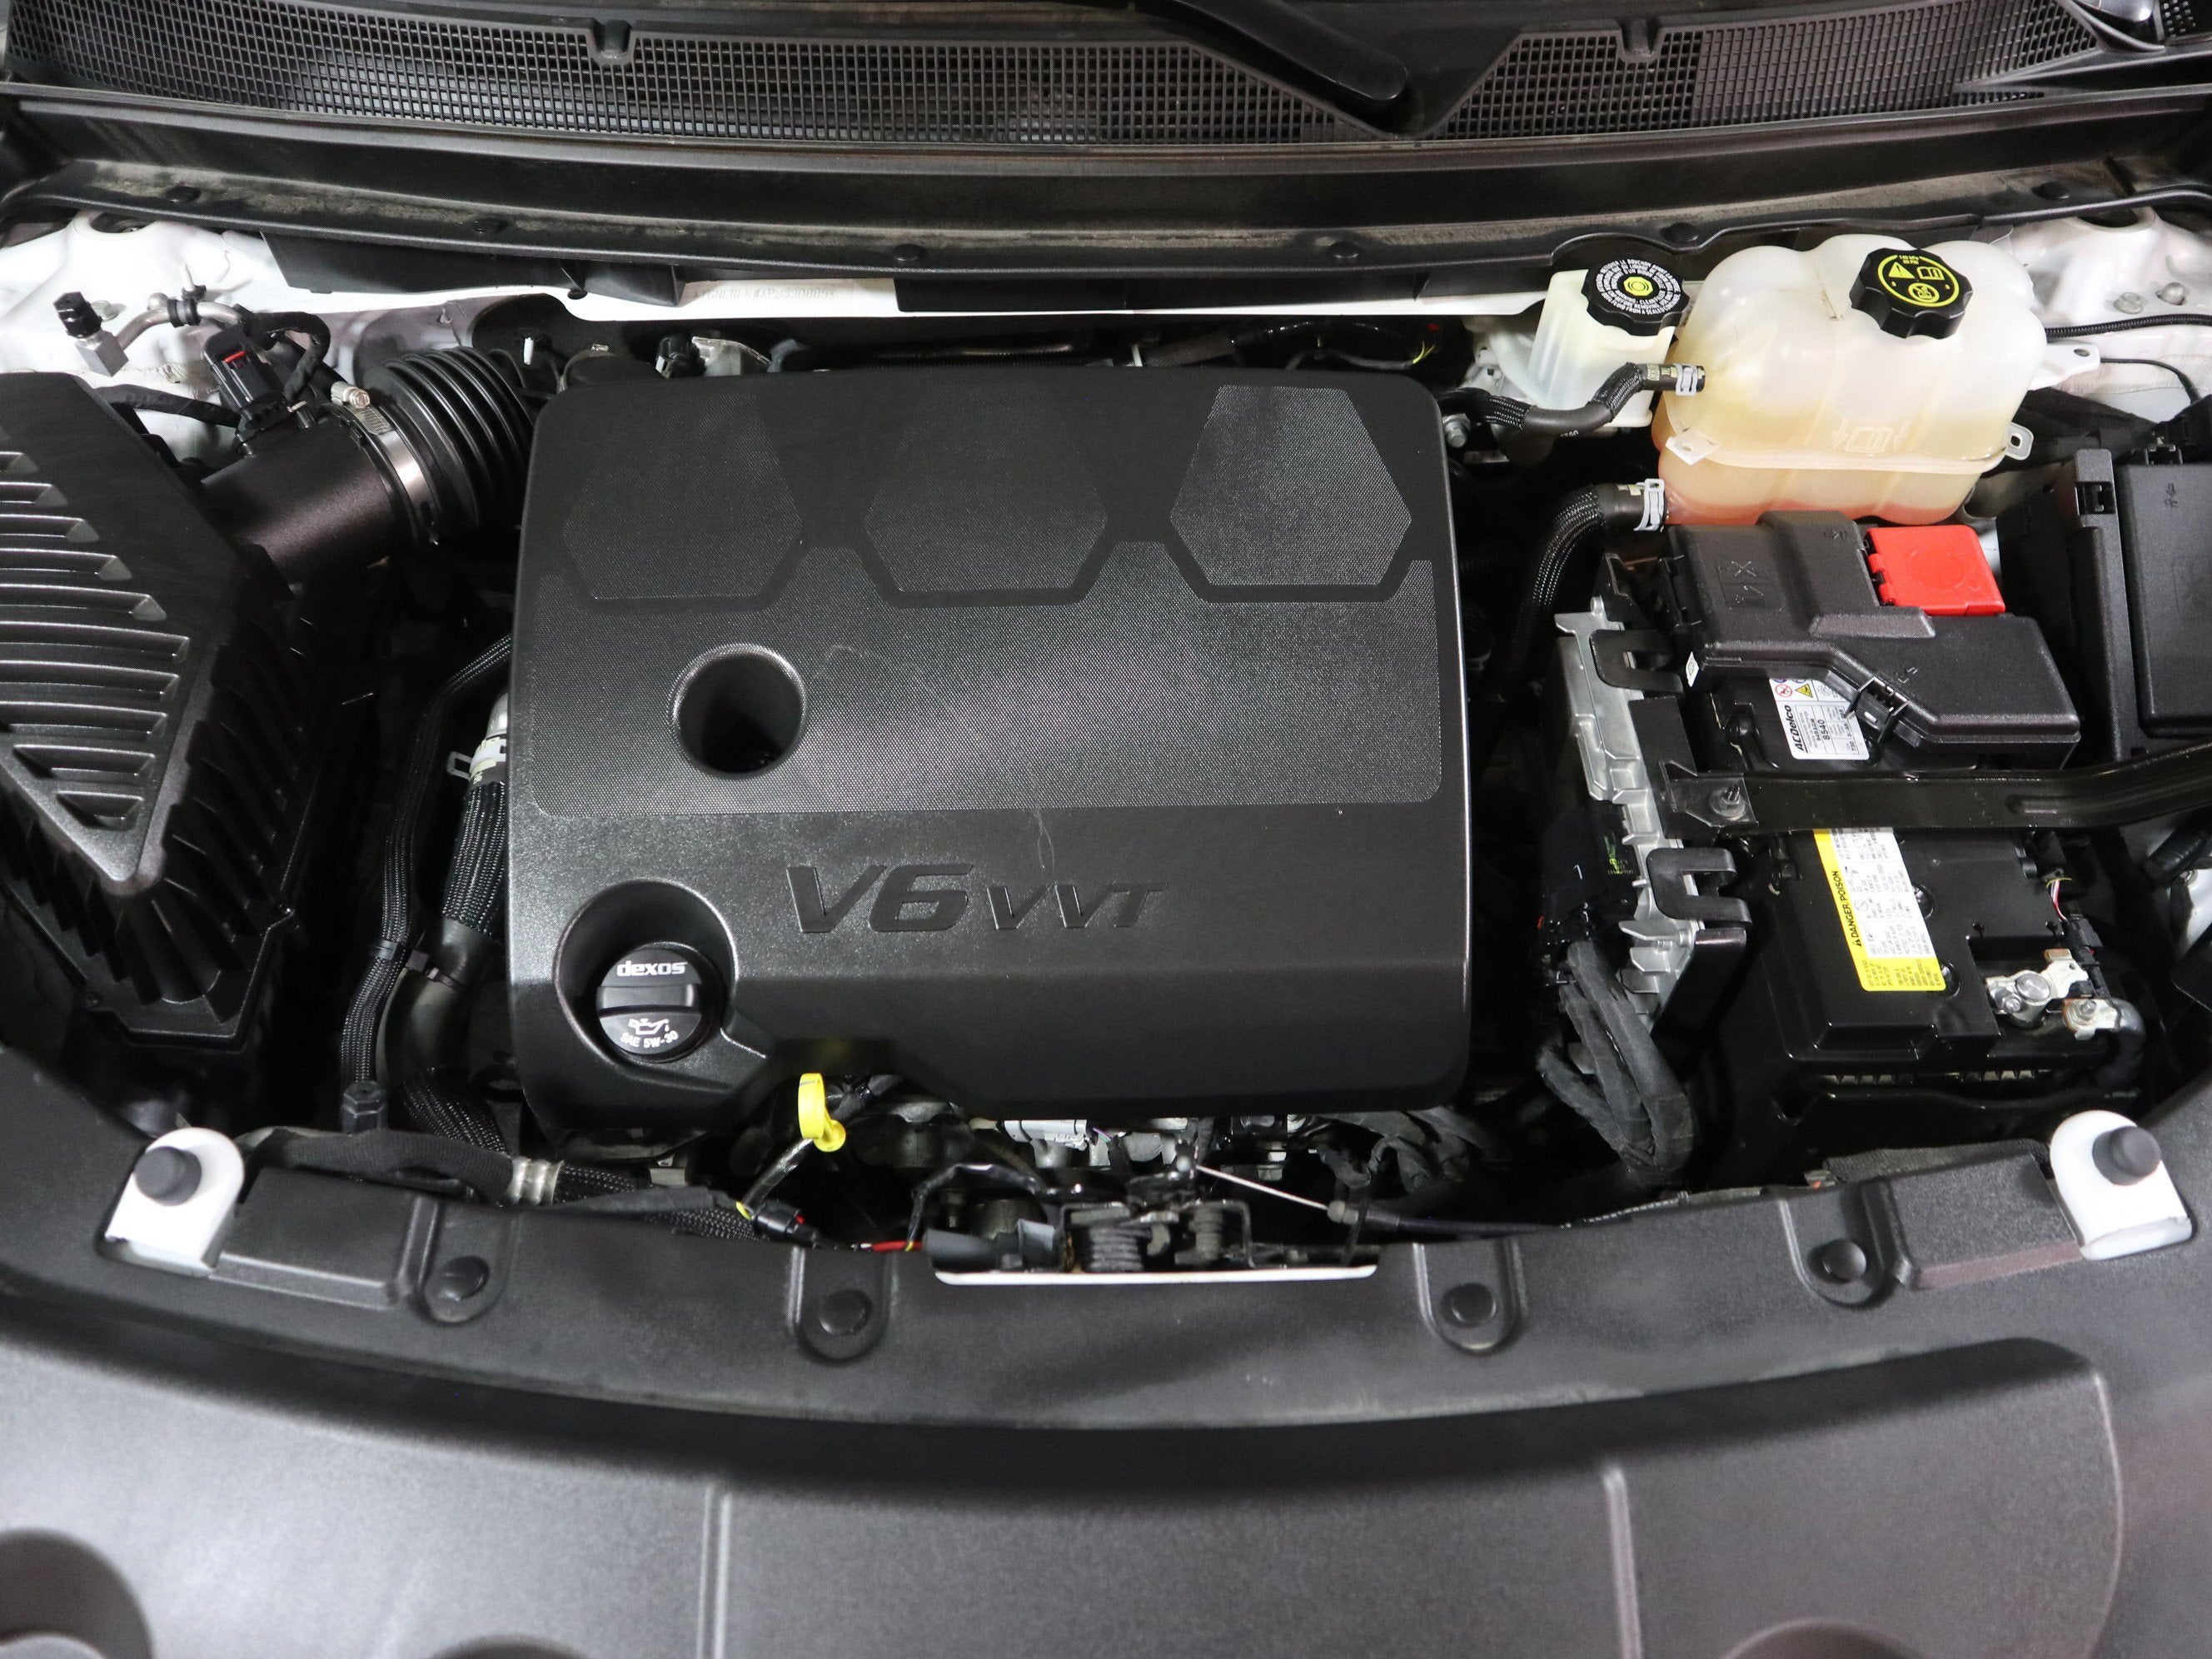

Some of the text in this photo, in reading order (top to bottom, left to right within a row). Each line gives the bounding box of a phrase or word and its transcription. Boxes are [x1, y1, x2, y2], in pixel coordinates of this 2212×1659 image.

[1784, 705, 1804, 751] ACDelco
[1817, 719, 1831, 740] 8540
[786, 864, 1167, 933] V6 VVT
[616, 960, 685, 977] dexos
[620, 1030, 679, 1049] SAE 5W-30
